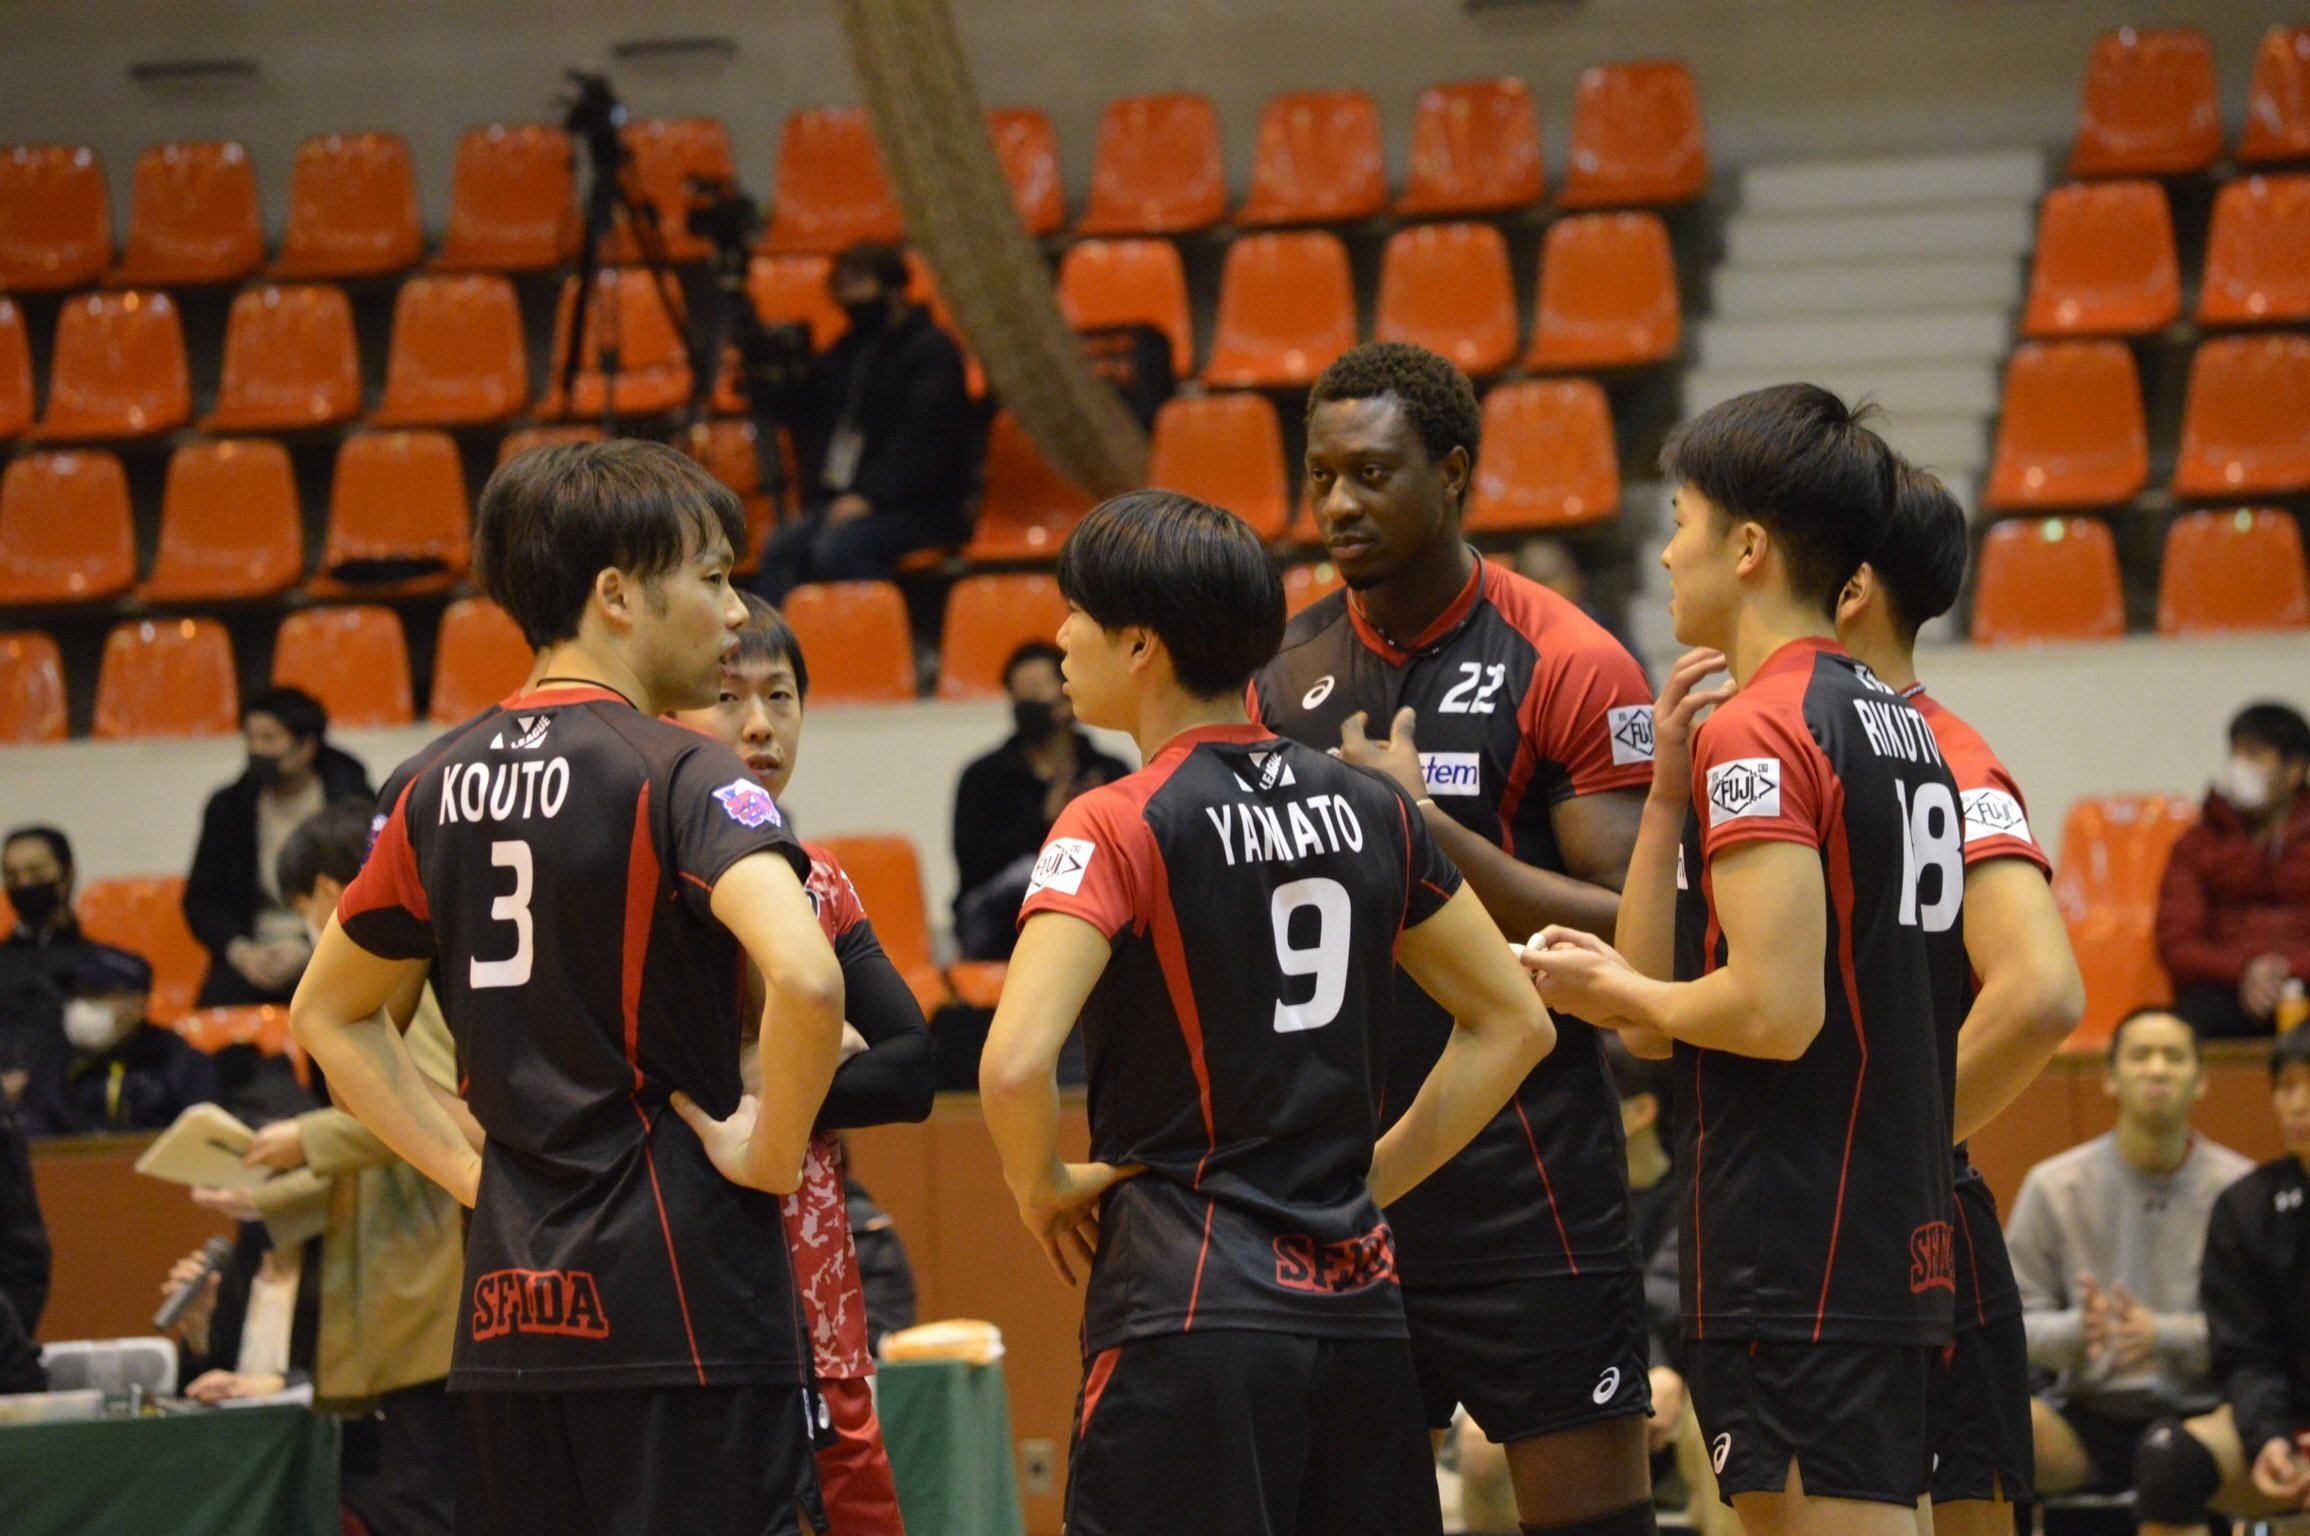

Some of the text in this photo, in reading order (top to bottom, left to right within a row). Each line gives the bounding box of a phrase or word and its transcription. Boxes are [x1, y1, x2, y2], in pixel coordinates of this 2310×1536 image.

[1438, 661, 1506, 714] 22
[439, 757, 570, 825] KOUTO
[1421, 756, 1477, 784] tem
[1721, 775, 1754, 809] FUJI
[1206, 795, 1363, 866] YAMATO
[1895, 778, 1964, 932] 18
[470, 840, 533, 989] 3
[1271, 878, 1351, 1033] 9
[473, 1268, 609, 1341] SFIDA
